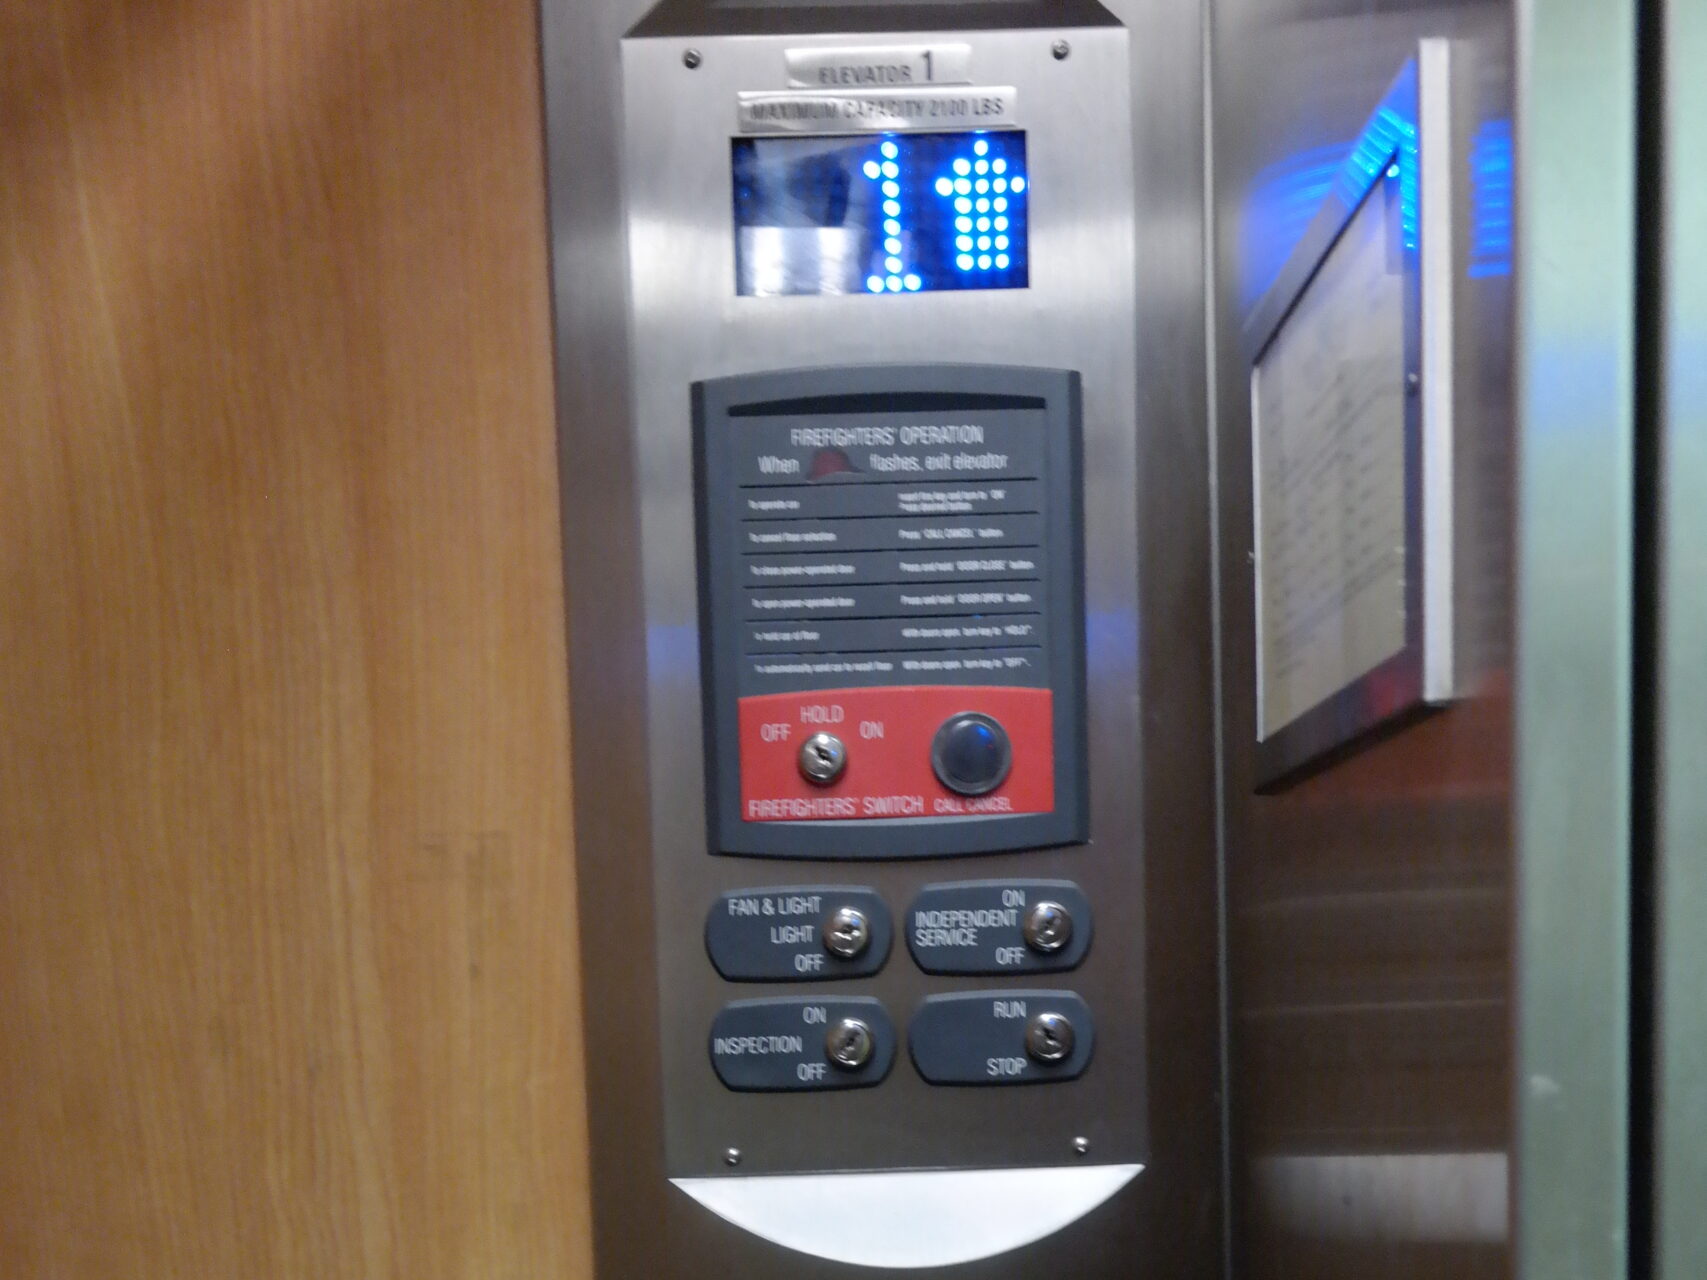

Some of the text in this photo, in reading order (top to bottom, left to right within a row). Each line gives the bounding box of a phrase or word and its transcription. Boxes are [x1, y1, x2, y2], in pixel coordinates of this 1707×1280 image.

[818, 50, 934, 84] ELEVATOR 1
[751, 97, 1004, 121] MAXIMUM CAPACITY 2100 LBS
[862, 140, 922, 293] 1
[900, 425, 984, 445] OPERATION
[758, 456, 800, 474] When
[953, 452, 1008, 470] elevator
[800, 705, 844, 723] HOLD
[761, 723, 791, 742] OFF
[860, 720, 884, 738] ON
[863, 795, 924, 814] SWITCH
[933, 796, 964, 812] CALL
[728, 895, 822, 916] FAN & LIGHT
[1002, 889, 1025, 907] ON
[915, 909, 1019, 928] INDEPENDENT
[771, 925, 815, 944] LIGHT
[915, 928, 978, 947] SERVICE
[794, 953, 824, 972] OFF
[995, 947, 1025, 966] OFF
[803, 1006, 827, 1024] ON
[993, 1001, 1026, 1018] RUN
[714, 1035, 803, 1055] INSPECTION
[797, 1063, 827, 1082] OFF
[986, 1057, 1028, 1076] STOP
